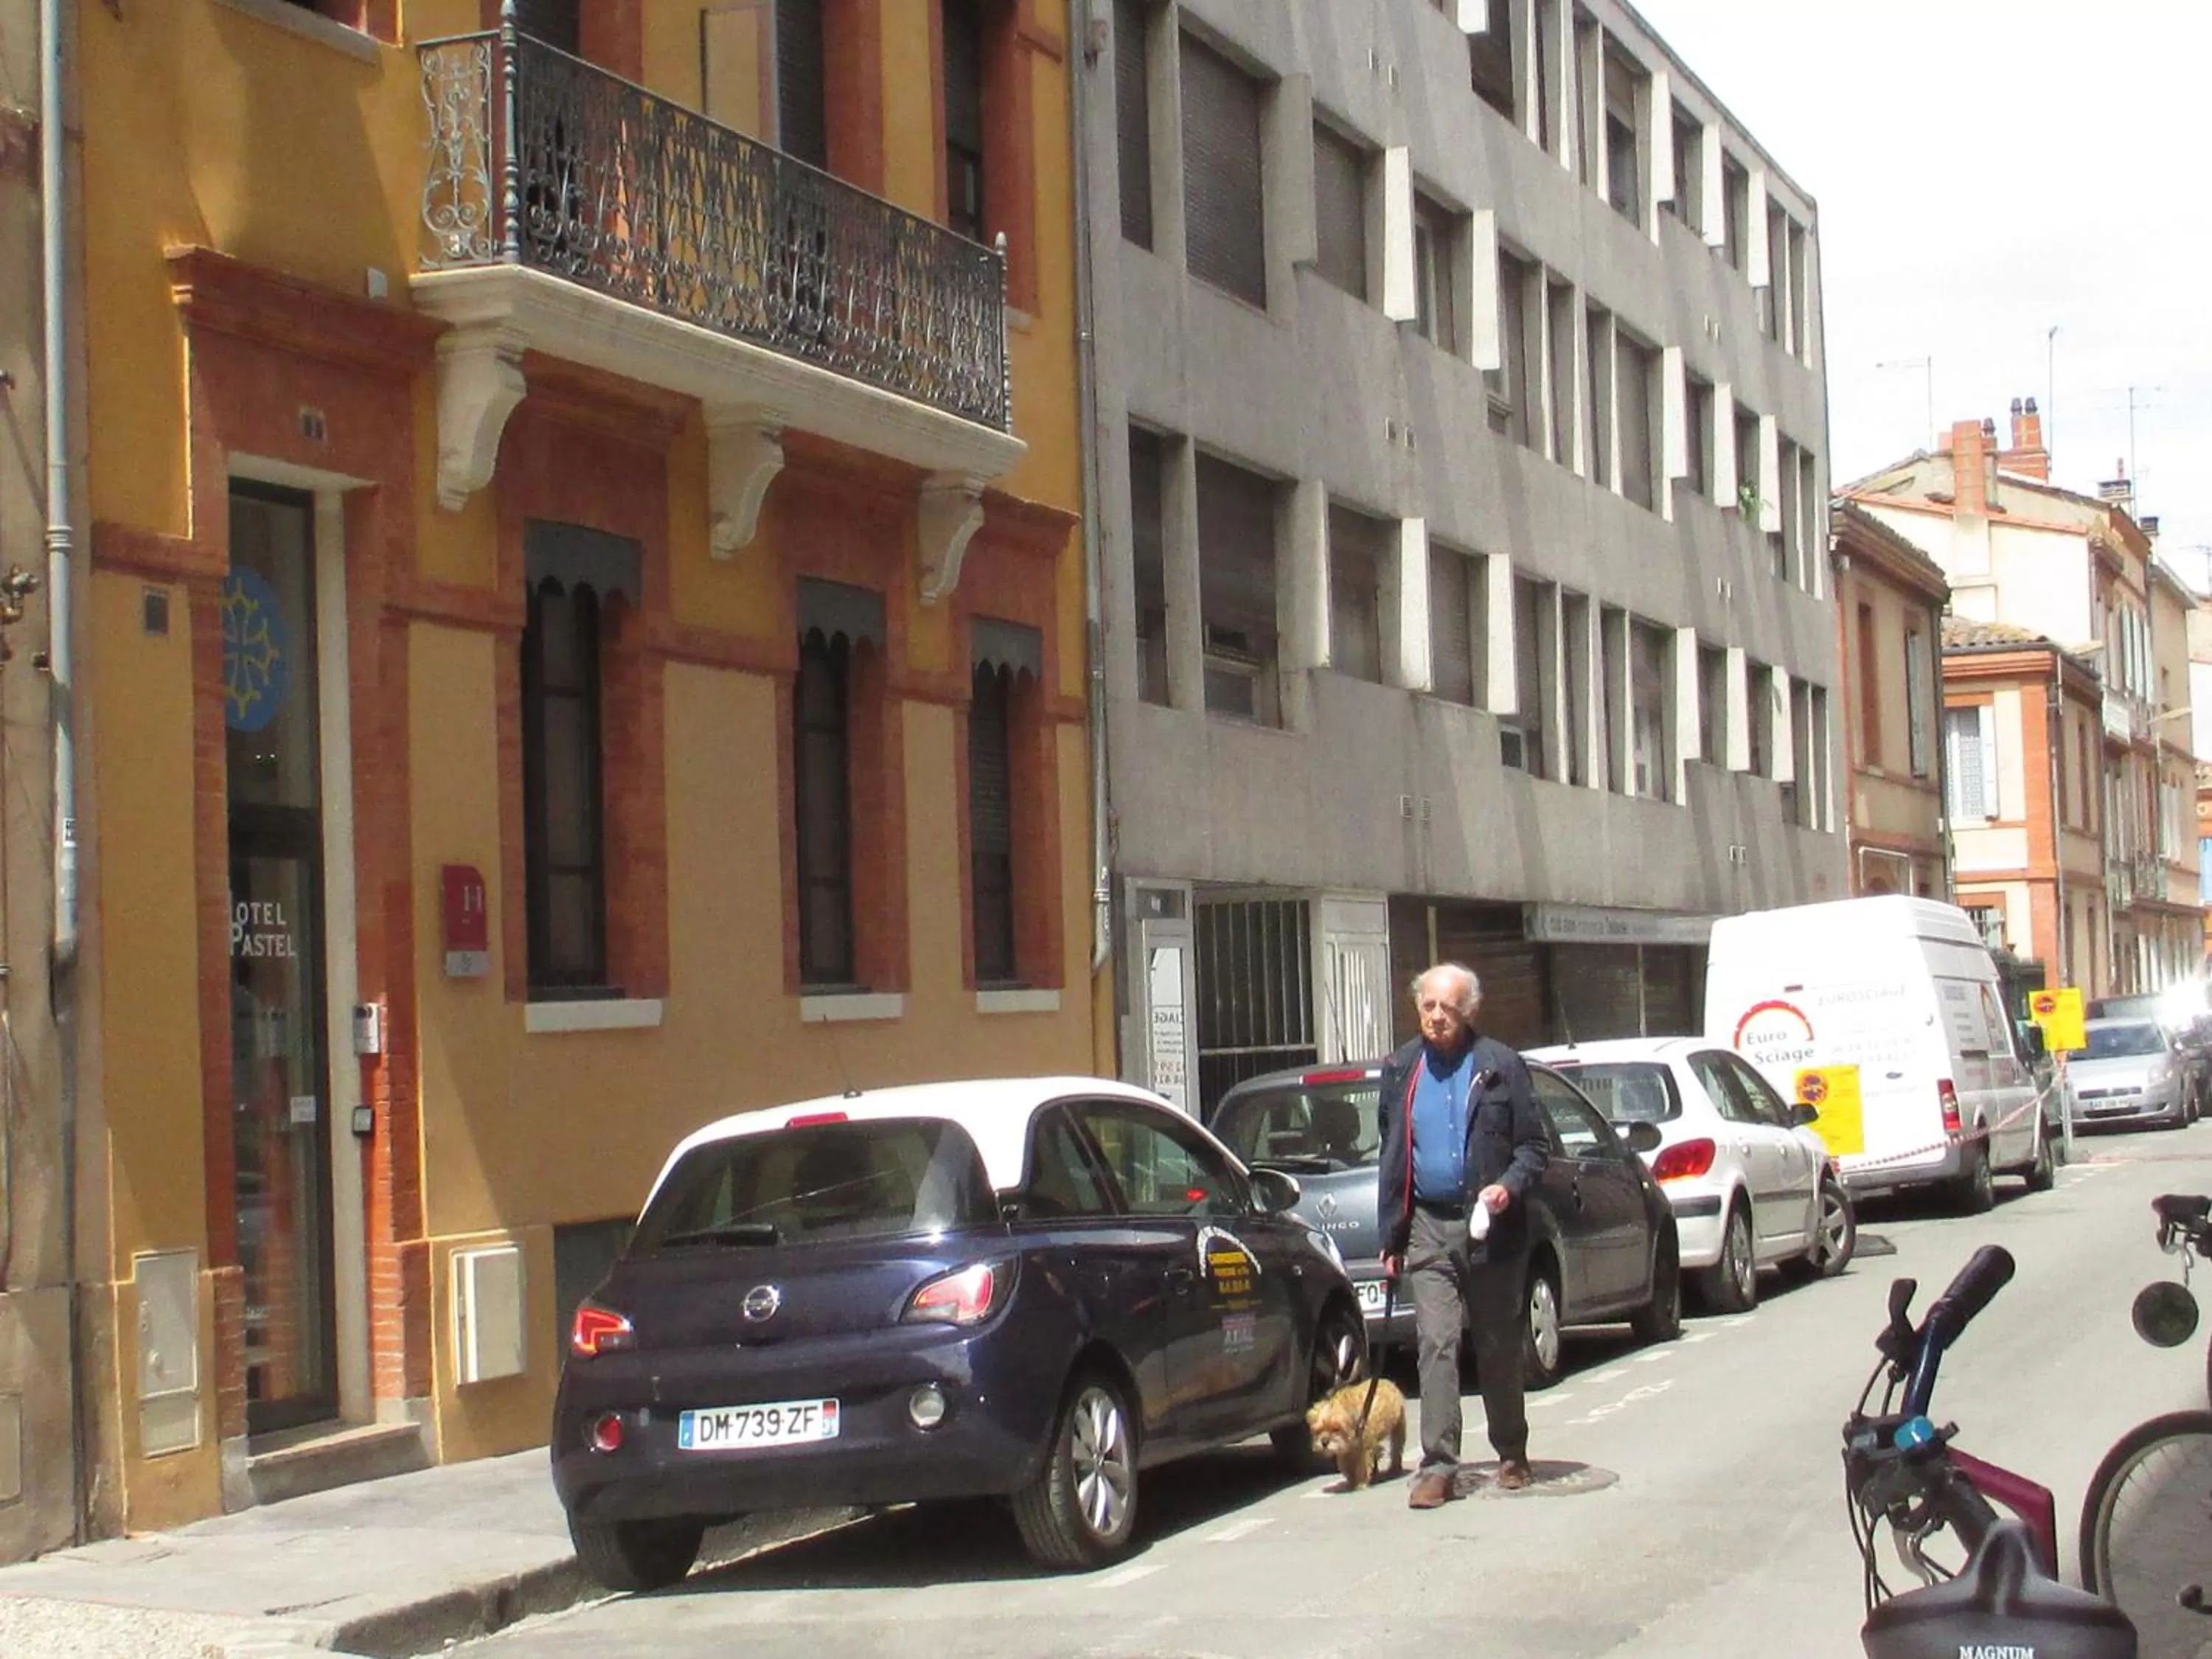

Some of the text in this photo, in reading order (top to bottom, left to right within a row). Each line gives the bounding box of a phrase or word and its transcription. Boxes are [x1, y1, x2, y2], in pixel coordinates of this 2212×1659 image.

[230, 922, 299, 956] PASTEL
[1746, 1031, 1788, 1046] Euro
[1754, 1048, 1815, 1065] Sciage
[1958, 1644, 2035, 1659] MAGNUM
